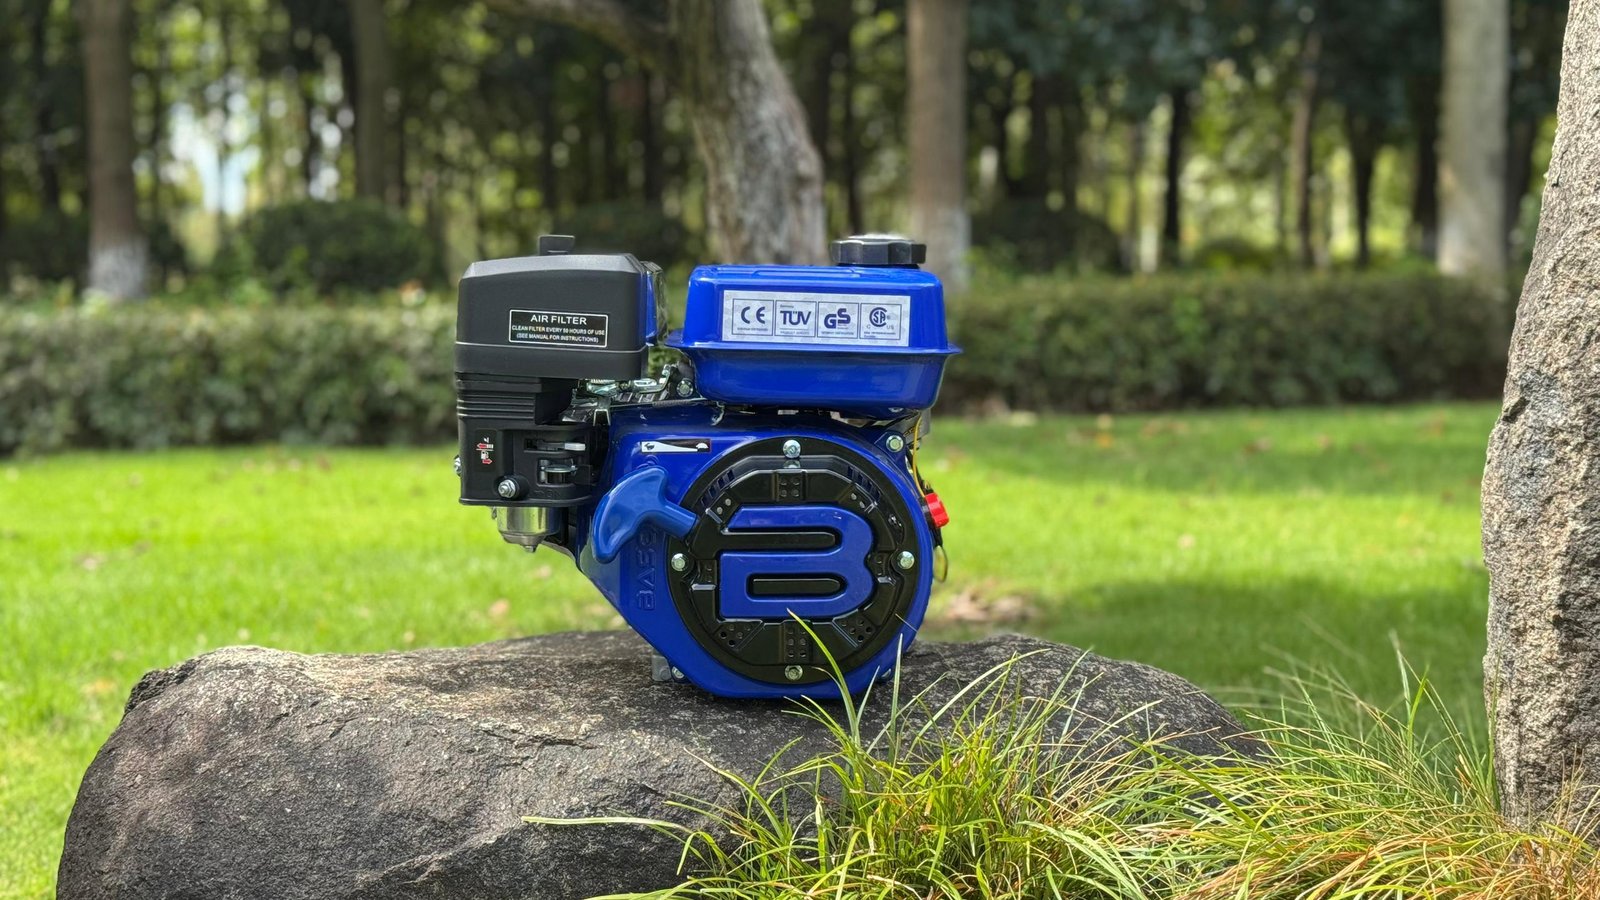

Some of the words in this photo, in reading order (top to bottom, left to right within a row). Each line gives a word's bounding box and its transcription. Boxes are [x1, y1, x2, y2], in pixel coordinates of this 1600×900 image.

[530, 314, 549, 323] AIR
[550, 316, 587, 325] FILTER
[741, 306, 766, 325] CE
[780, 310, 812, 326] TÜV
[824, 307, 851, 329] GS
[511, 324, 528, 332] CLEAN
[528, 325, 545, 333] FILTER
[569, 328, 587, 336] HOURS
[528, 333, 549, 341] MANUAL
[560, 335, 599, 344] INSTRUCTIONS)
